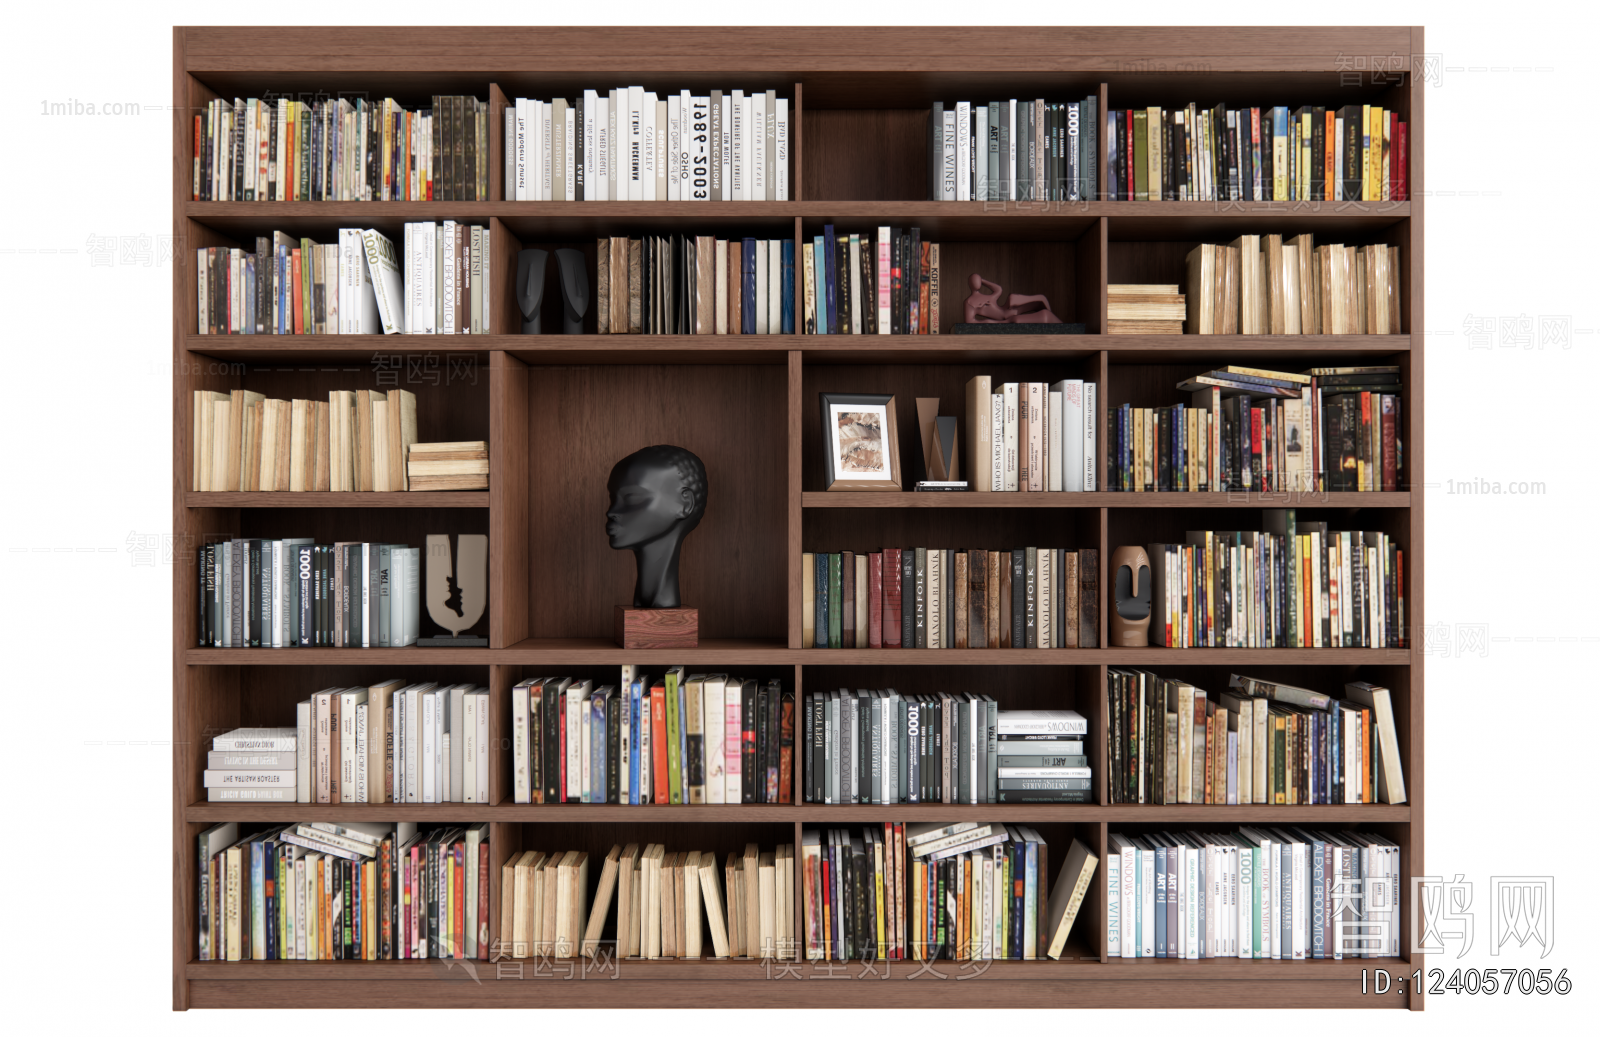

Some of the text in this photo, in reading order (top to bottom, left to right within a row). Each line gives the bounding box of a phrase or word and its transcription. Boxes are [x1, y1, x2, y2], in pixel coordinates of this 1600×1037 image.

[959, 105, 967, 147] WINDOWS
[1068, 106, 1079, 136] 1000
[946, 124, 954, 192] FINE WINES
[363, 233, 379, 265] 1000
[445, 223, 454, 328] ALEXEY BRODOVITCH
[1047, 722, 1084, 731] WINDOWS
[1052, 758, 1066, 766] ART
[1125, 850, 1133, 895] WINDOWS
[1241, 852, 1251, 884] 1000
[1109, 869, 1118, 942] FINE WINES
[1314, 843, 1323, 950] ALEXEY BRODOVITCH
